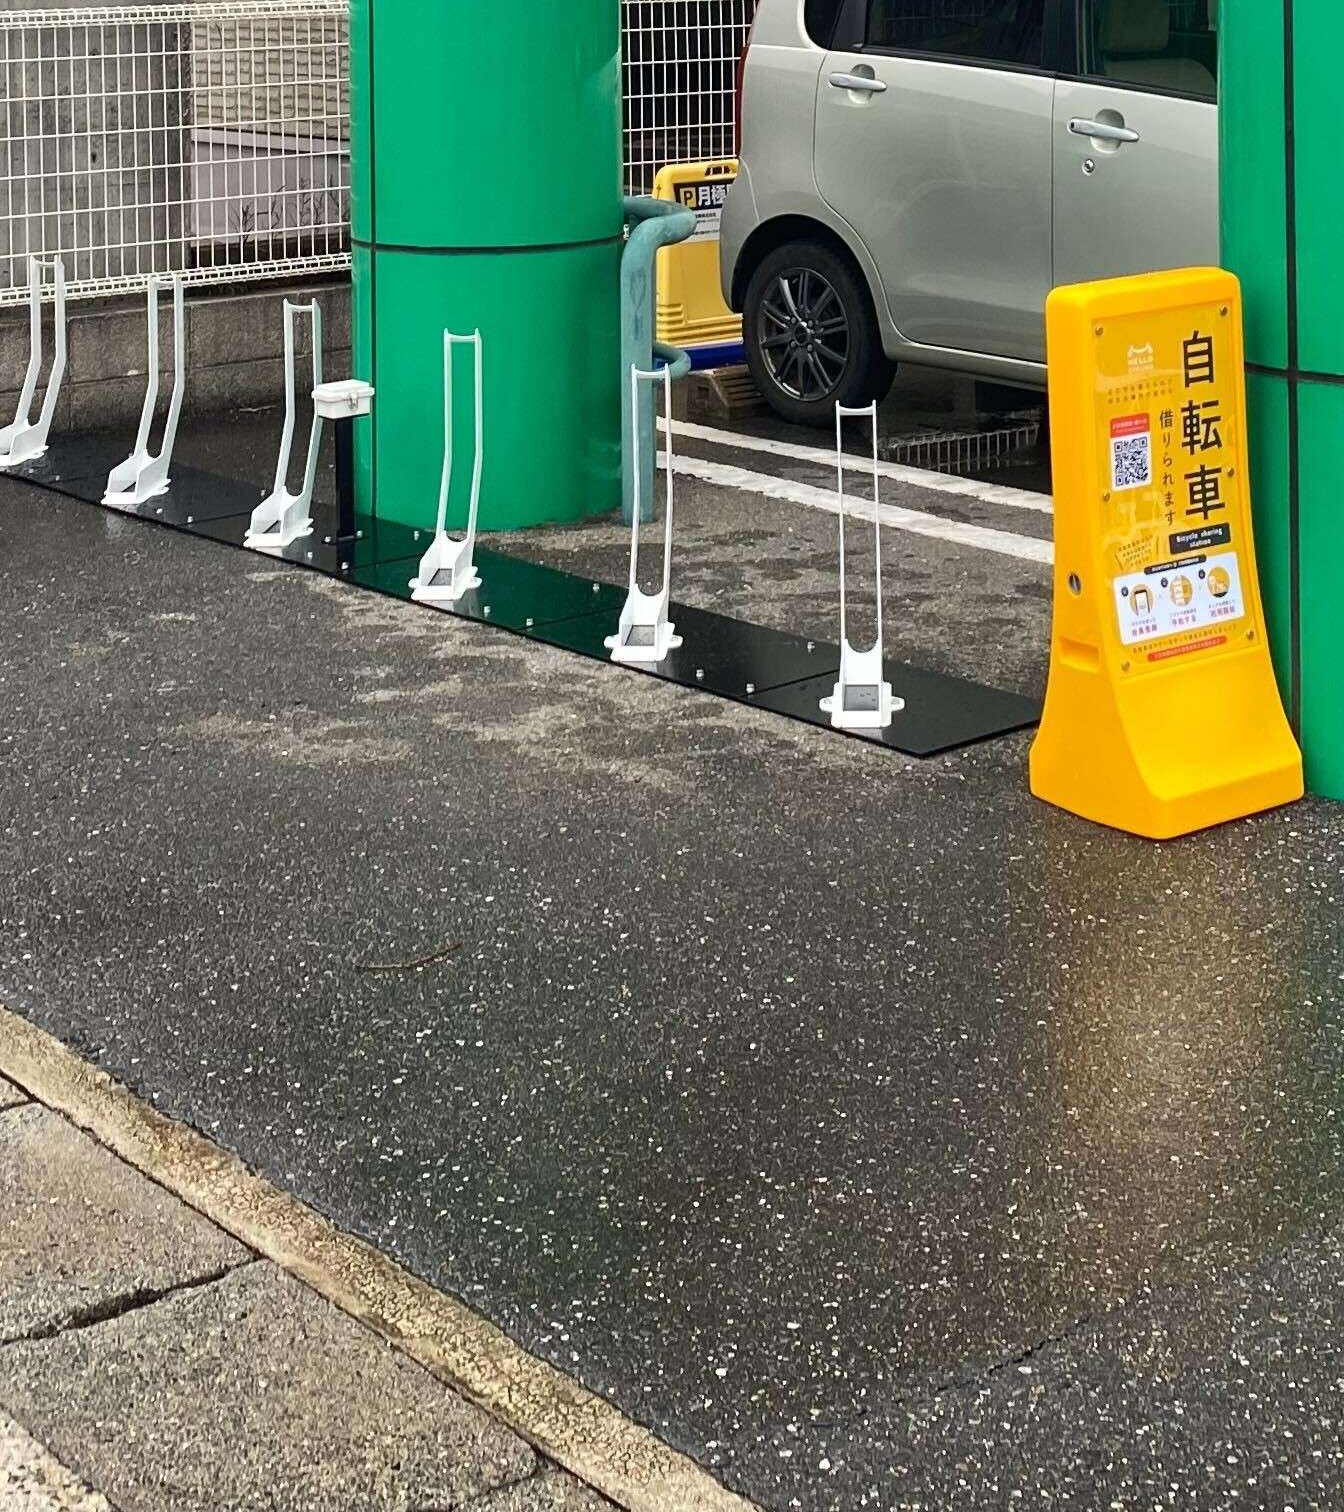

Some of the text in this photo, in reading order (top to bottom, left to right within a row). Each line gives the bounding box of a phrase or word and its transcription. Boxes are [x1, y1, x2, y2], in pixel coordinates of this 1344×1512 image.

[1159, 407, 1177, 527] 借りられます
[1181, 330, 1226, 520] 自転車
